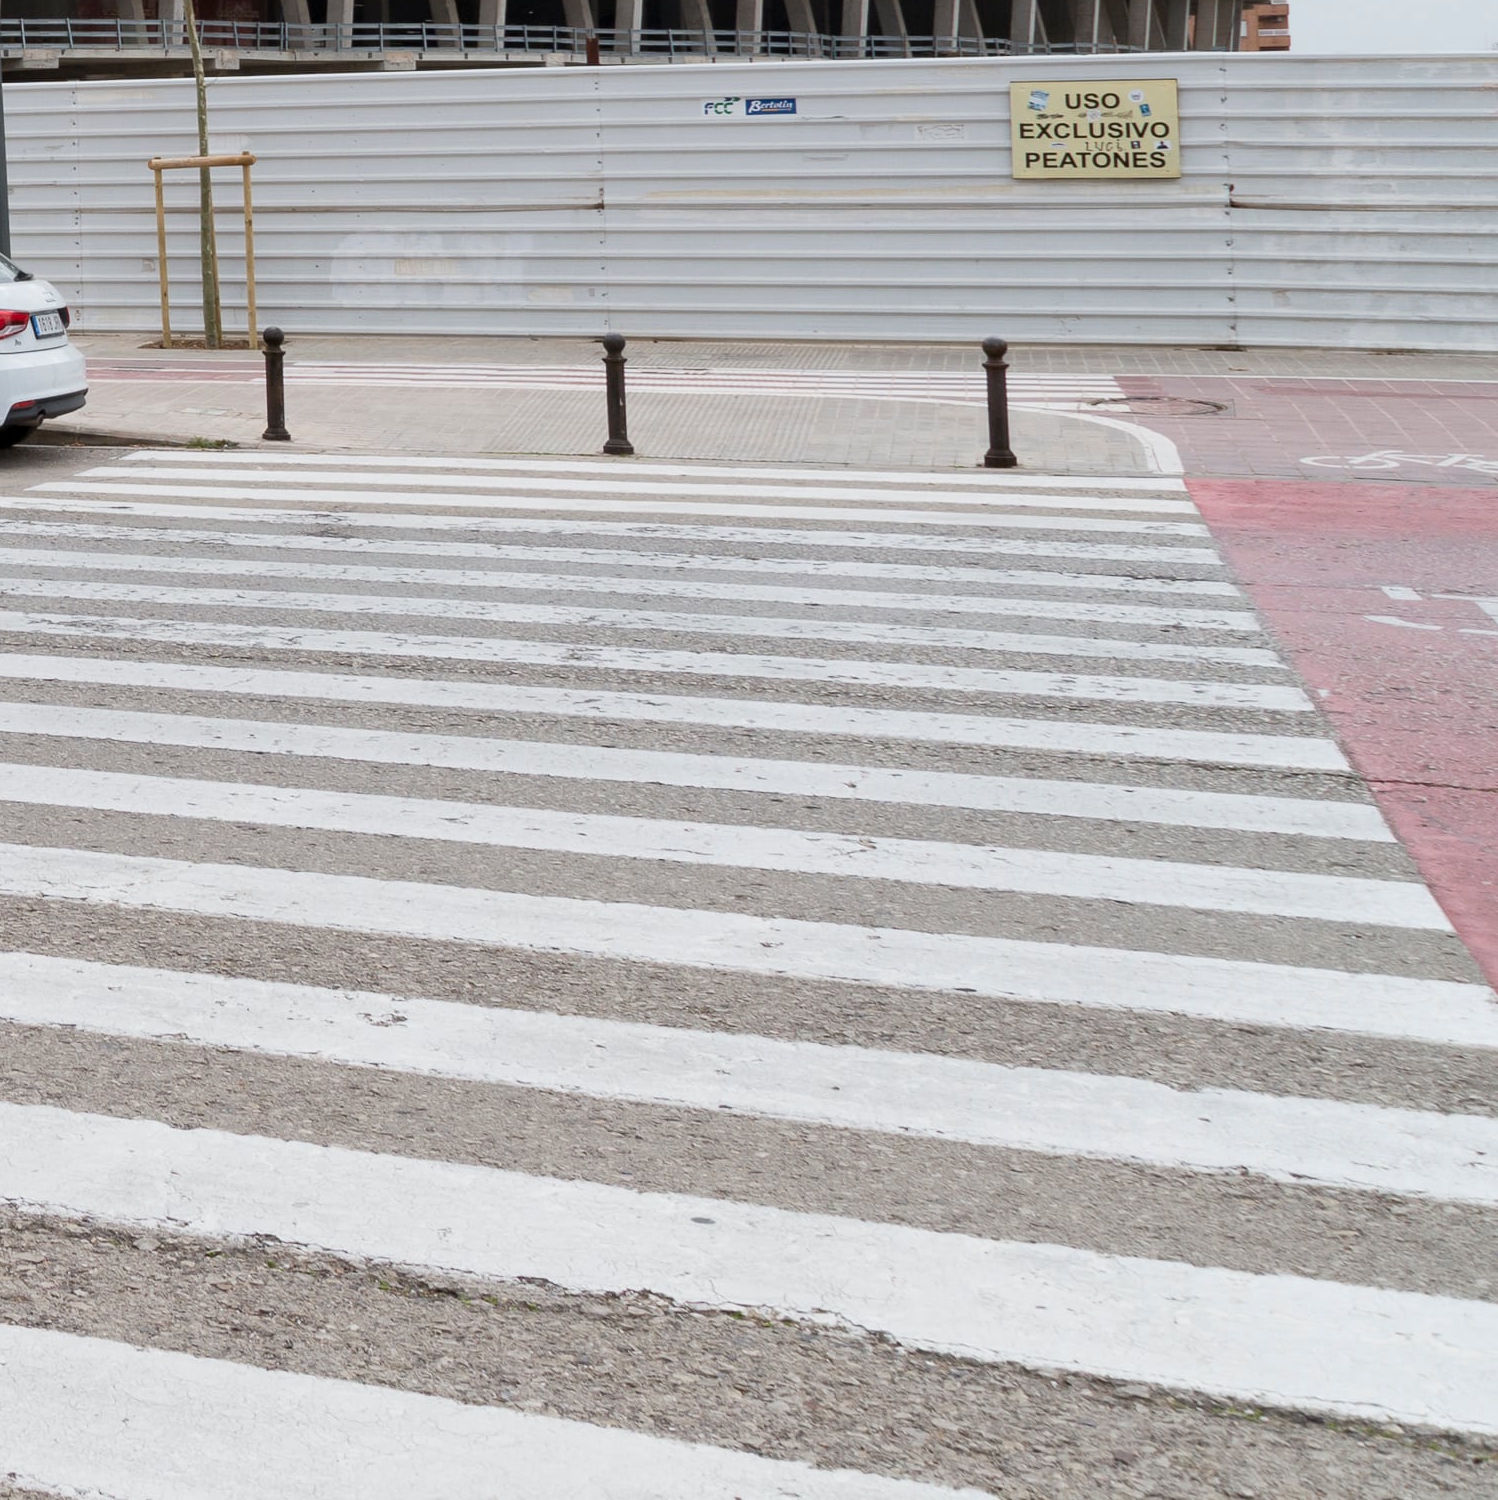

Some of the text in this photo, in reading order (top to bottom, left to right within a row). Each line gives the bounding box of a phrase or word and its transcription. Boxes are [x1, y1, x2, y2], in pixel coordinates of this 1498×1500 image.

[704, 102, 733, 115] FCC
[1065, 92, 1120, 109] USO
[1019, 122, 1170, 139] EXCLUSIVO
[1025, 152, 1166, 169] PEATONES
